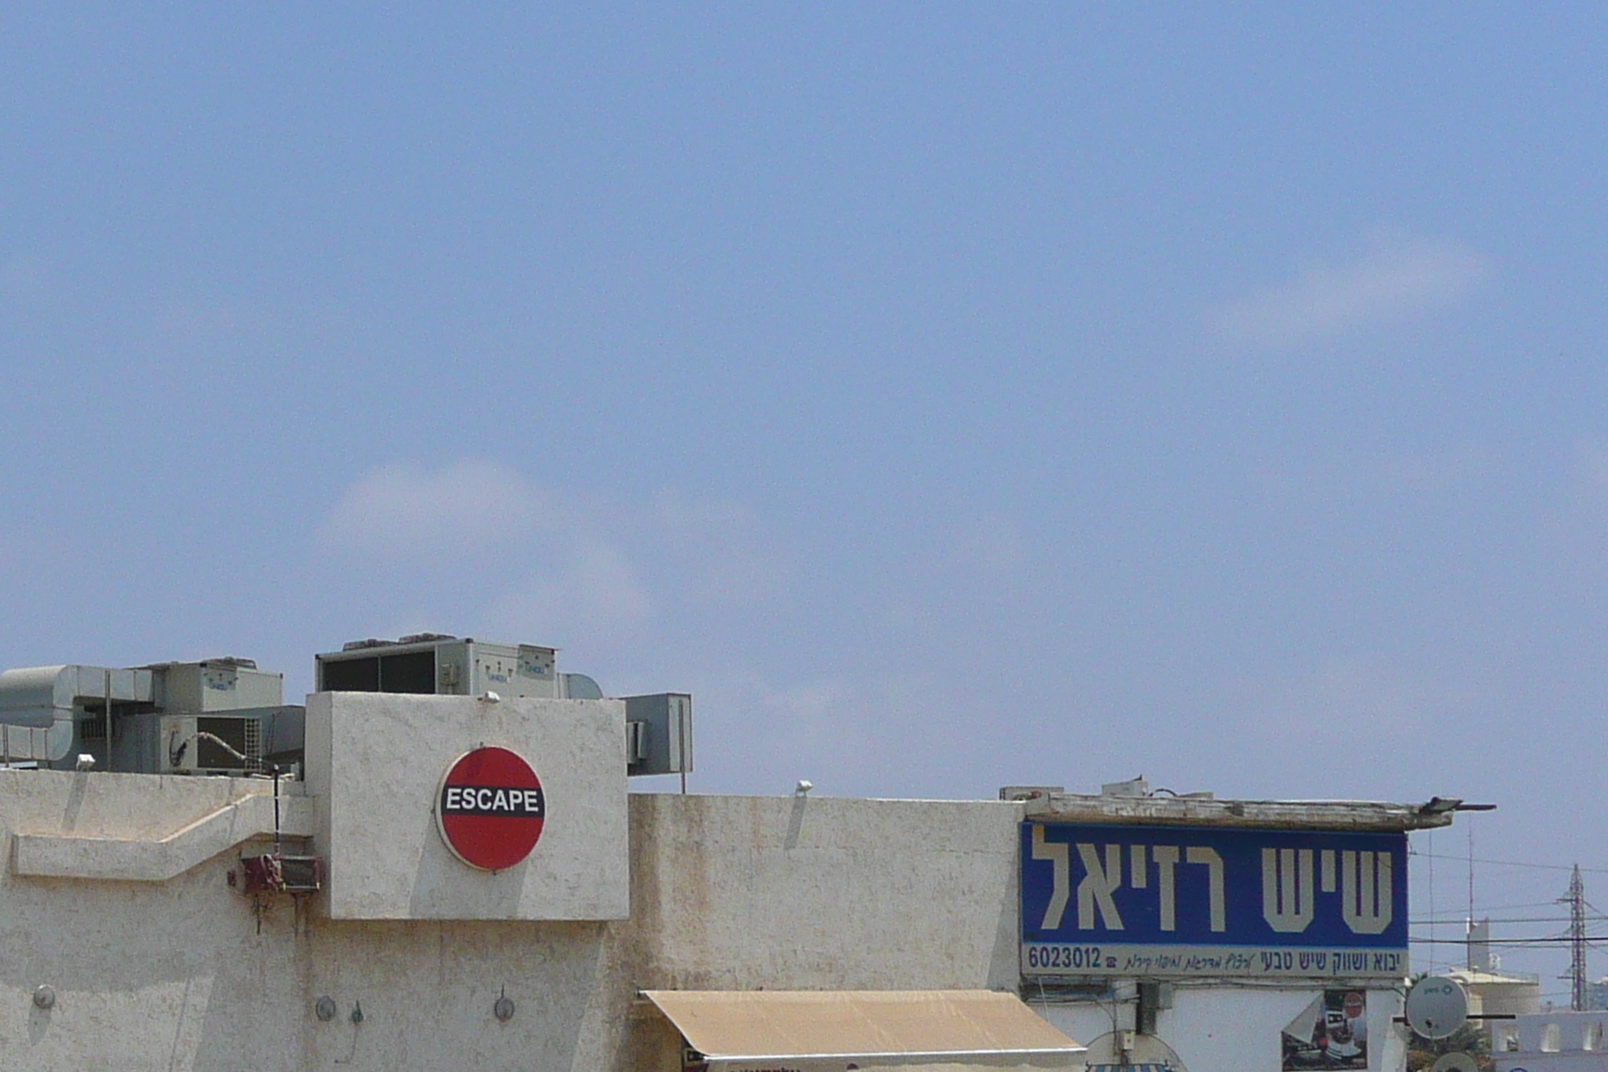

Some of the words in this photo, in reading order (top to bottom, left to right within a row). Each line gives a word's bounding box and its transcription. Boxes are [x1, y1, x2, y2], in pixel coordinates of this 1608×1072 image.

[446, 787, 539, 812] ESCAPE
[1031, 824, 1226, 933] רזיאל
[1261, 847, 1392, 935] שיש
[1028, 946, 1101, 969] 6023012
[1260, 951, 1293, 971] טבעי
[1299, 951, 1326, 971] שיש
[1332, 952, 1368, 975] ושווק
[1373, 952, 1400, 971] יבוא
